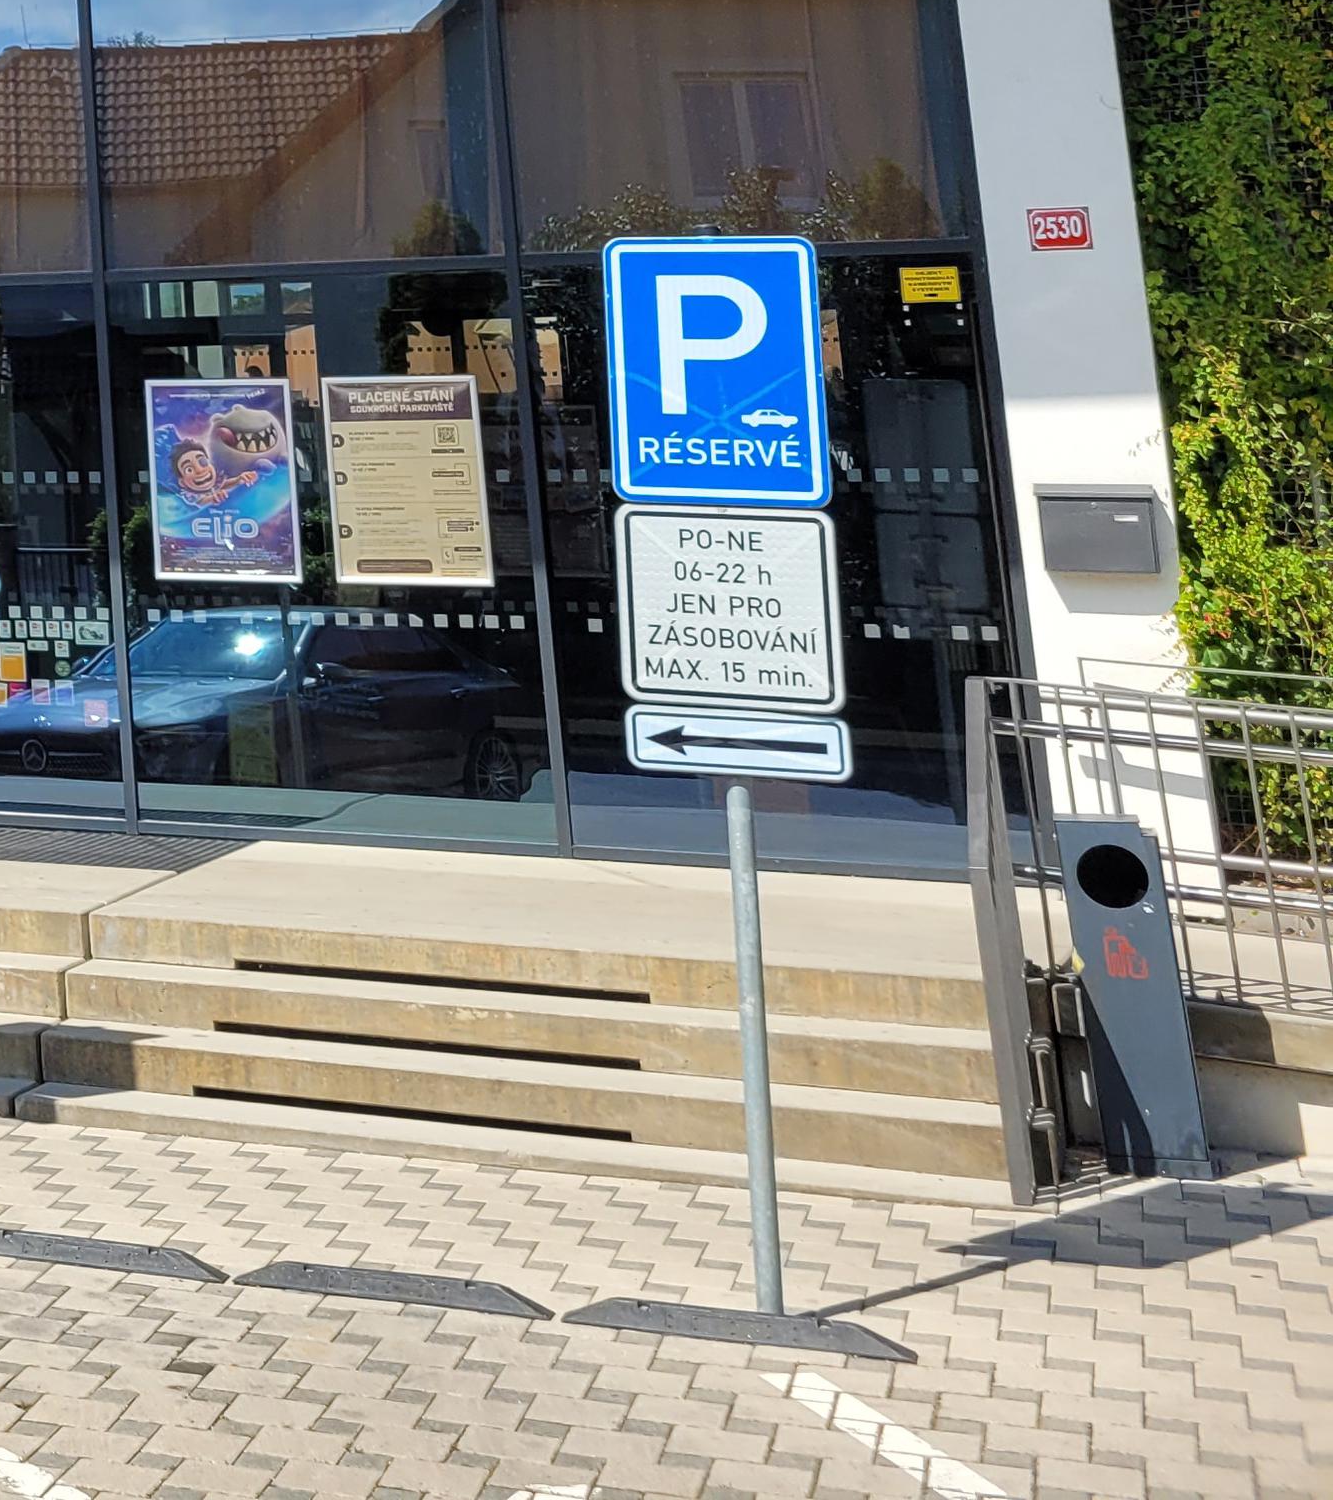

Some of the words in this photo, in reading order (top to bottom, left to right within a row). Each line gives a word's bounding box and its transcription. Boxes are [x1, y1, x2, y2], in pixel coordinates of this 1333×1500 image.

[1033, 216, 1083, 240] 2530
[655, 274, 768, 415] P
[348, 388, 411, 404] PLACENÉ
[413, 386, 455, 402] STÁNÍ
[349, 403, 399, 414] SOUKROMÉ
[400, 402, 455, 413] PARKOVIŠTĚ
[638, 431, 802, 467] RÉSERVÉ
[678, 528, 764, 552] PO-NE
[673, 560, 746, 584] 06-22
[757, 564, 772, 586] h
[666, 592, 716, 615] JEN
[729, 596, 782, 618] PRO
[647, 620, 818, 654] ZÁSOBOVÁNÍ
[644, 656, 710, 681] MAX.
[721, 661, 746, 683] 15
[758, 665, 814, 688] min.
